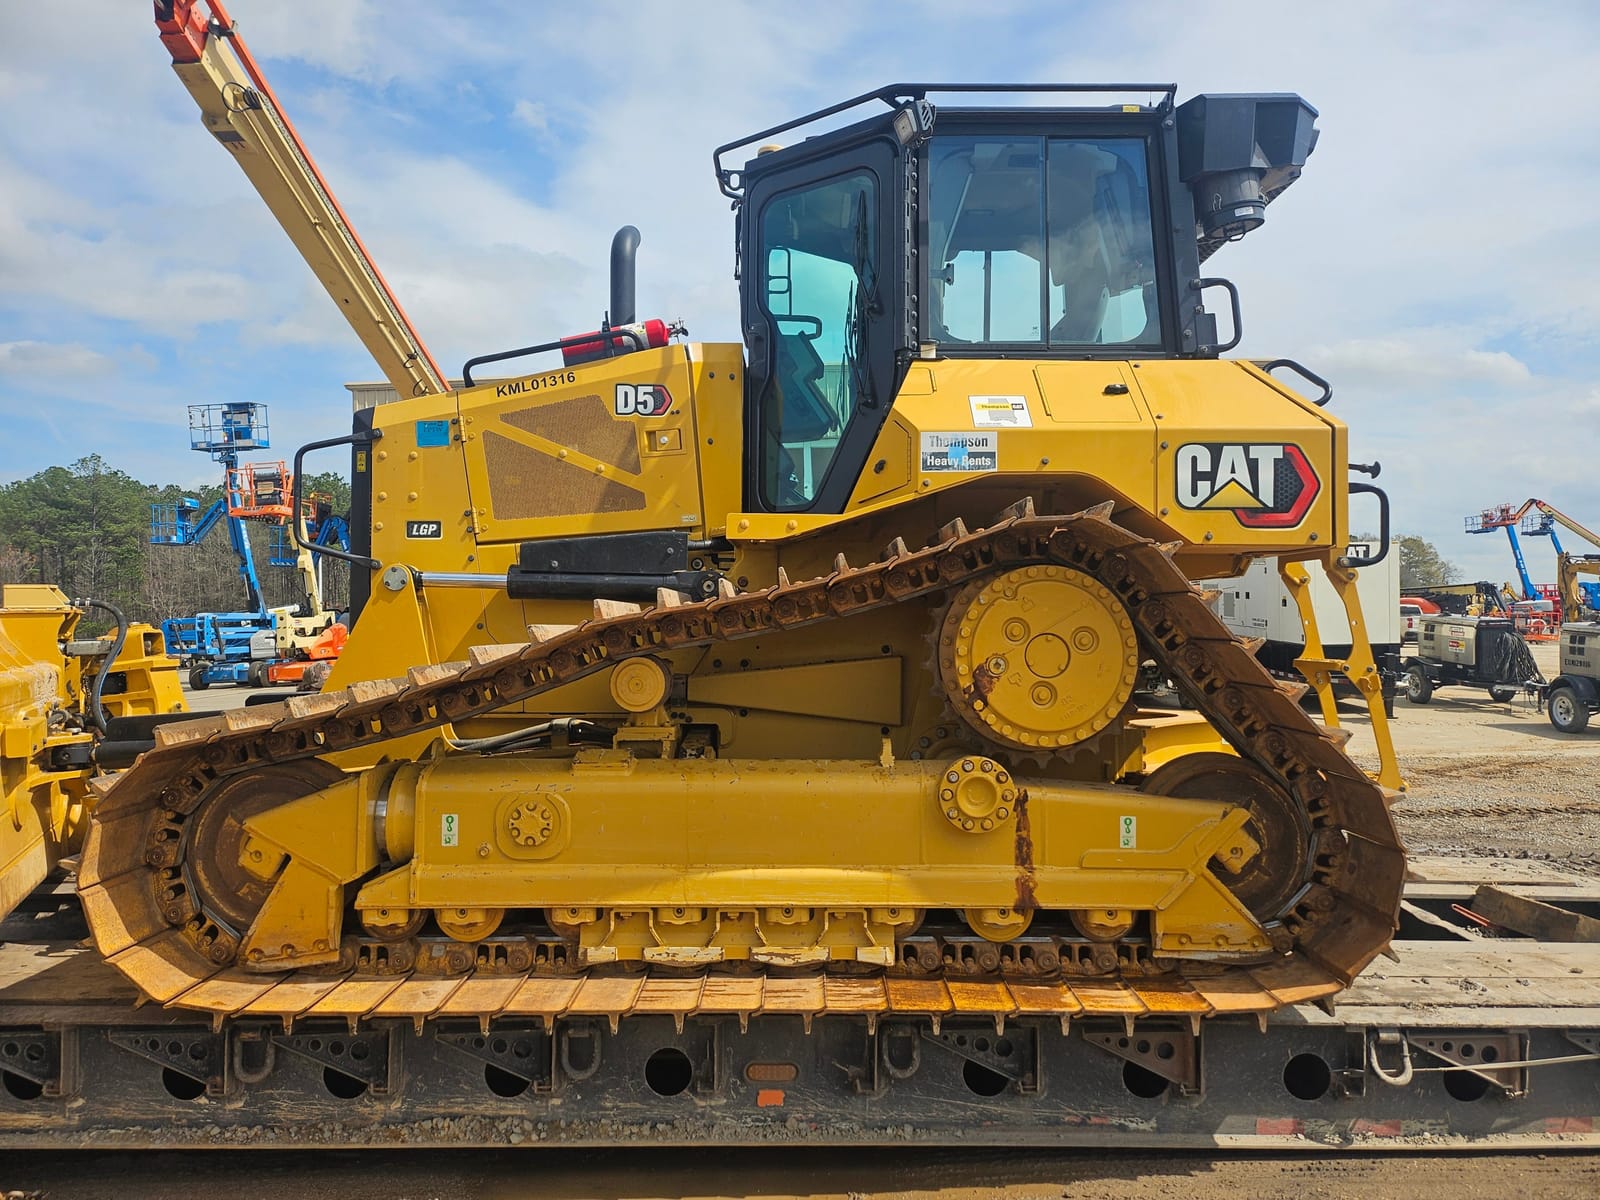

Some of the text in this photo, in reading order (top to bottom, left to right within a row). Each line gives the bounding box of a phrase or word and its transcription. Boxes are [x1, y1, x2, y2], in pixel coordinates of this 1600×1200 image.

[496, 371, 576, 398] KML01316
[615, 385, 654, 414] D5
[928, 435, 989, 449] Thompson
[926, 455, 959, 468] Heavy
[1177, 444, 1284, 508] CAT
[412, 523, 437, 536] LGP
[1346, 545, 1367, 559] AT
